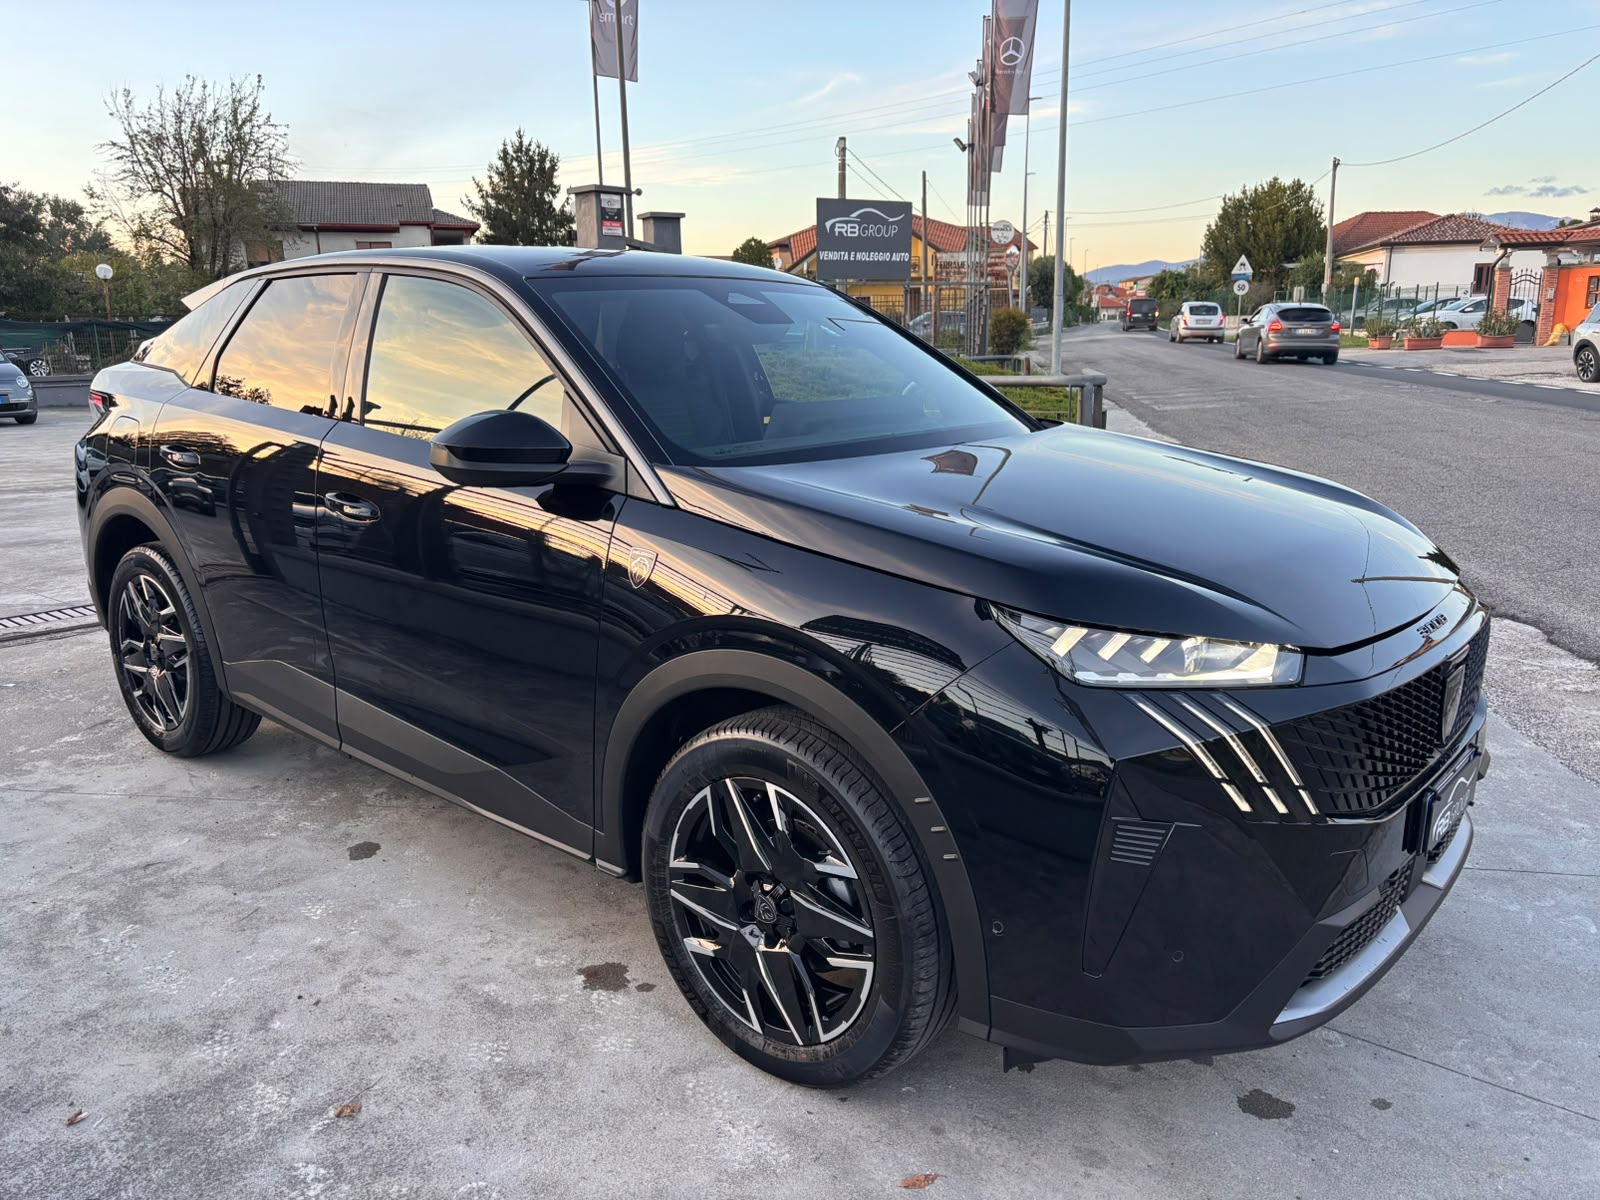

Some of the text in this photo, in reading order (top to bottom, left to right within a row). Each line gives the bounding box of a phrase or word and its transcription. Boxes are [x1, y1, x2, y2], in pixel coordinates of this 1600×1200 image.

[599, 12, 633, 26] smrt
[819, 251, 910, 261] VENDITA E NOLEGGIO AUTO
[1237, 283, 1246, 292] 50
